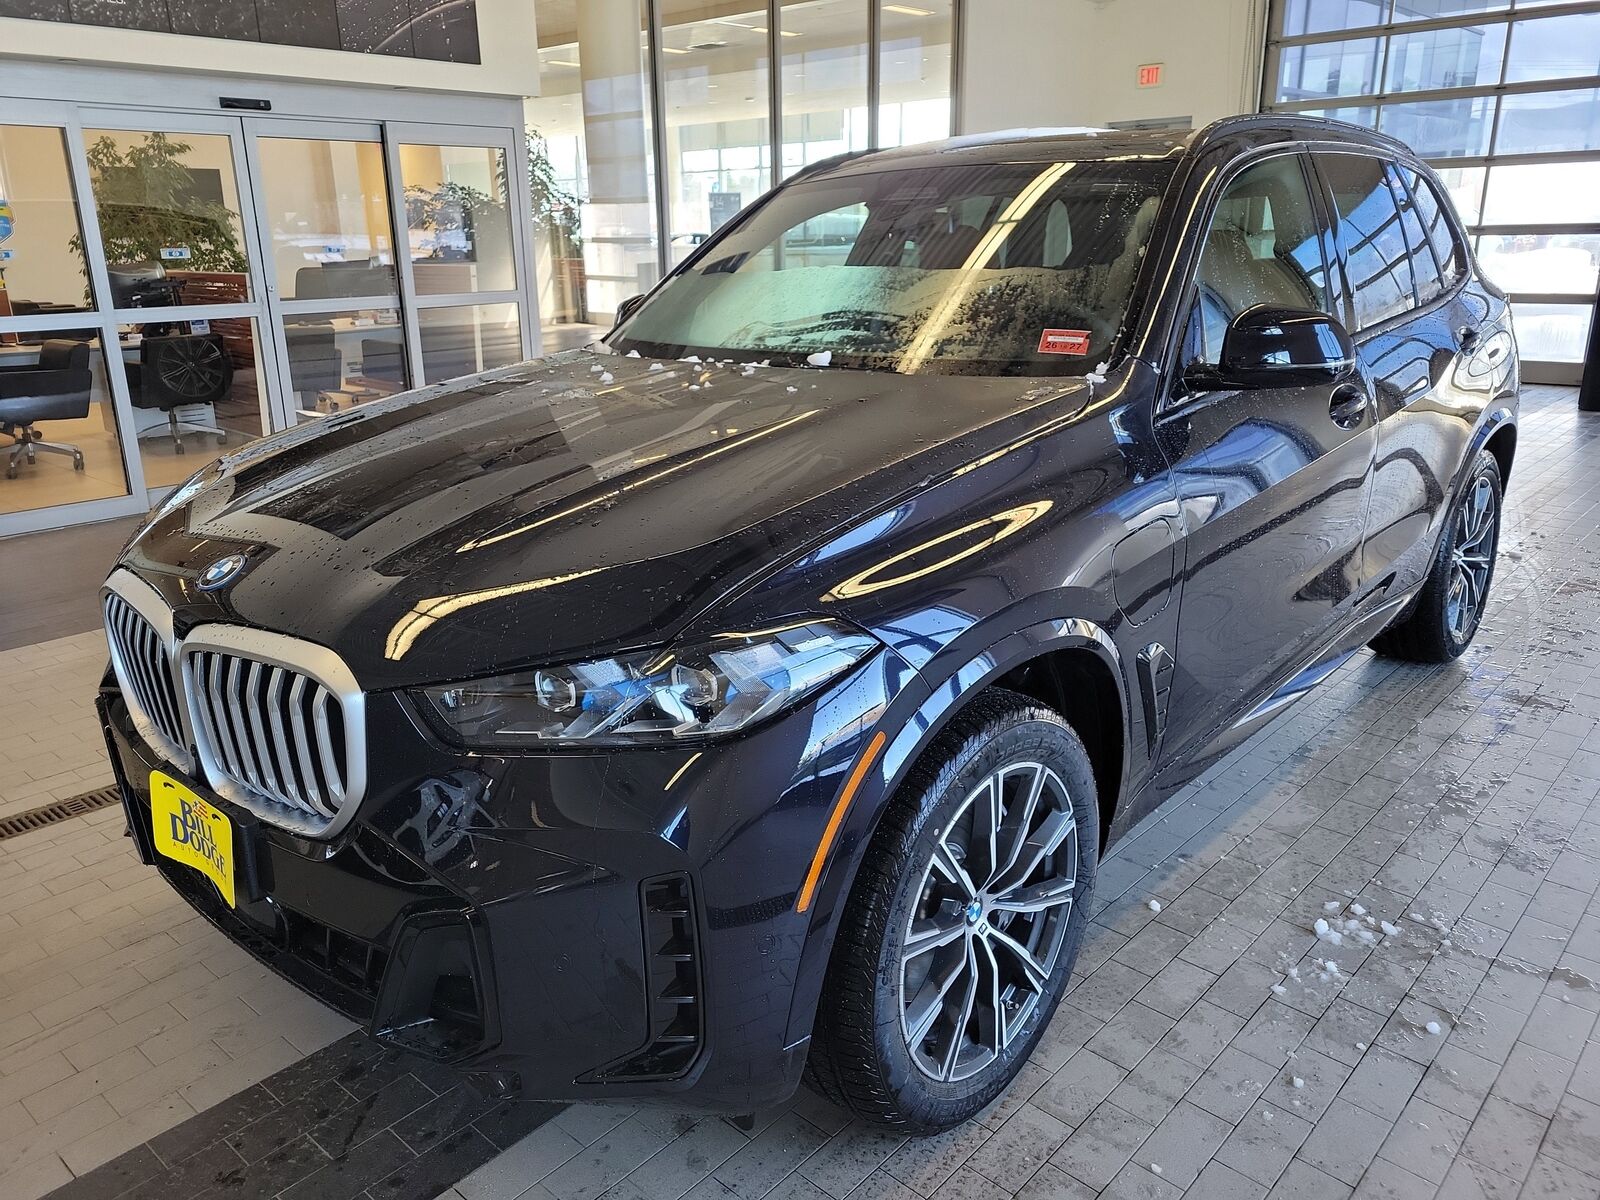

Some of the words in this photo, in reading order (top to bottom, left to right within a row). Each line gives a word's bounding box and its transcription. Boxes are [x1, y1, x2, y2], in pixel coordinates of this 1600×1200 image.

[1140, 67, 1160, 85] EXIT
[1045, 341, 1058, 349] 26
[1069, 342, 1082, 350] 27
[178, 797, 217, 848] BILL
[169, 812, 227, 878] DODGE
[172, 840, 199, 858] AUTO
